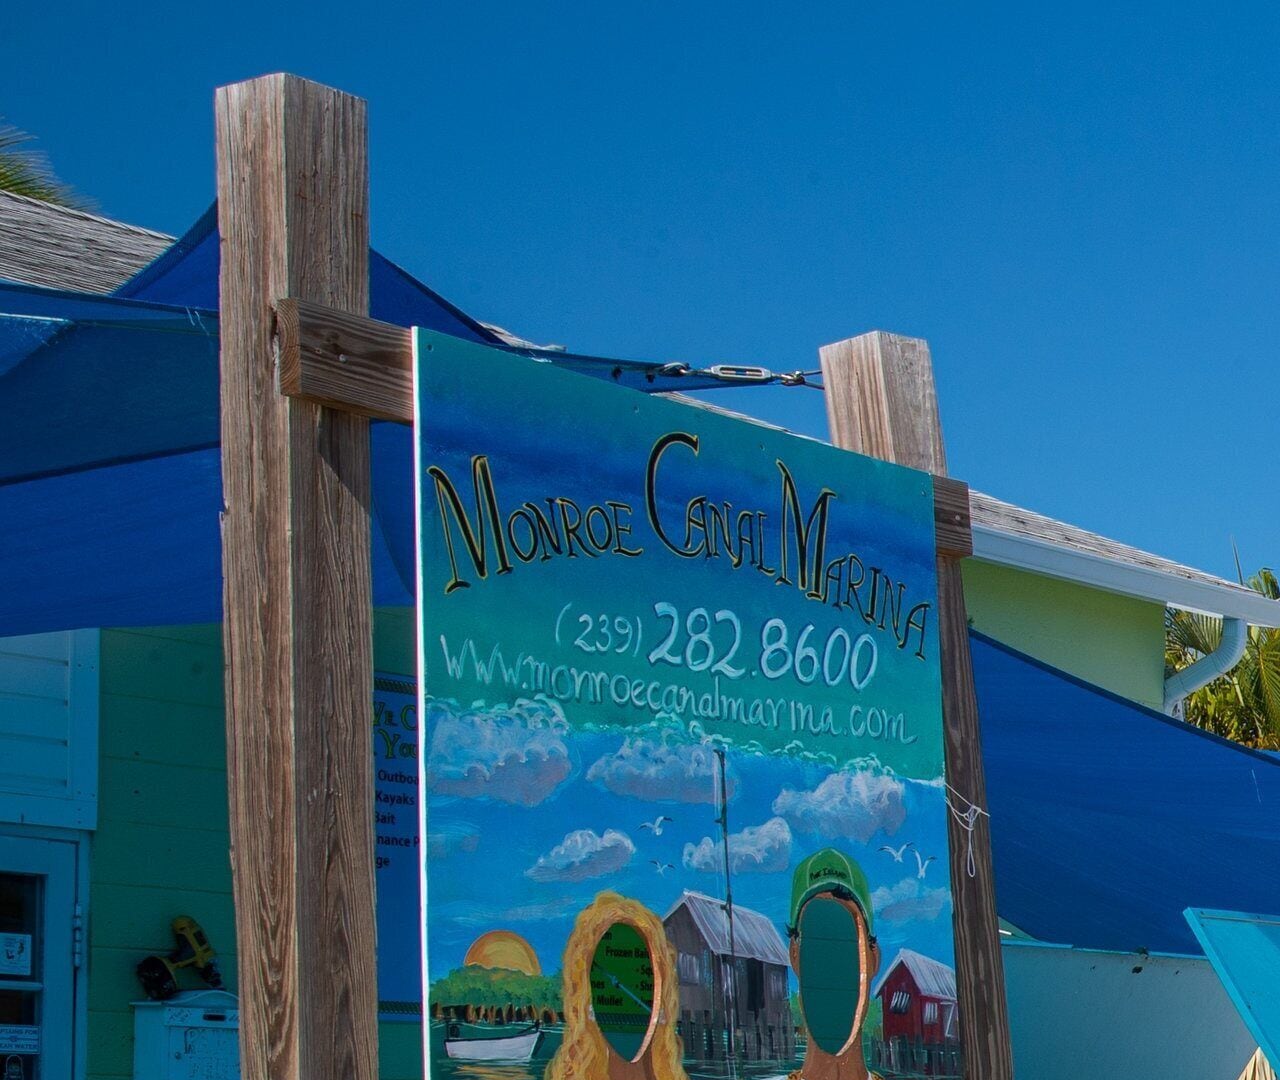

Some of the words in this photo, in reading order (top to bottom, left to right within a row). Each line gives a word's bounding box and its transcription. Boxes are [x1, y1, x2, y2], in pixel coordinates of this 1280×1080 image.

[555, 602, 642, 657] (239)
[648, 602, 879, 690] 282.8600
[375, 789, 415, 807] Kayaks
